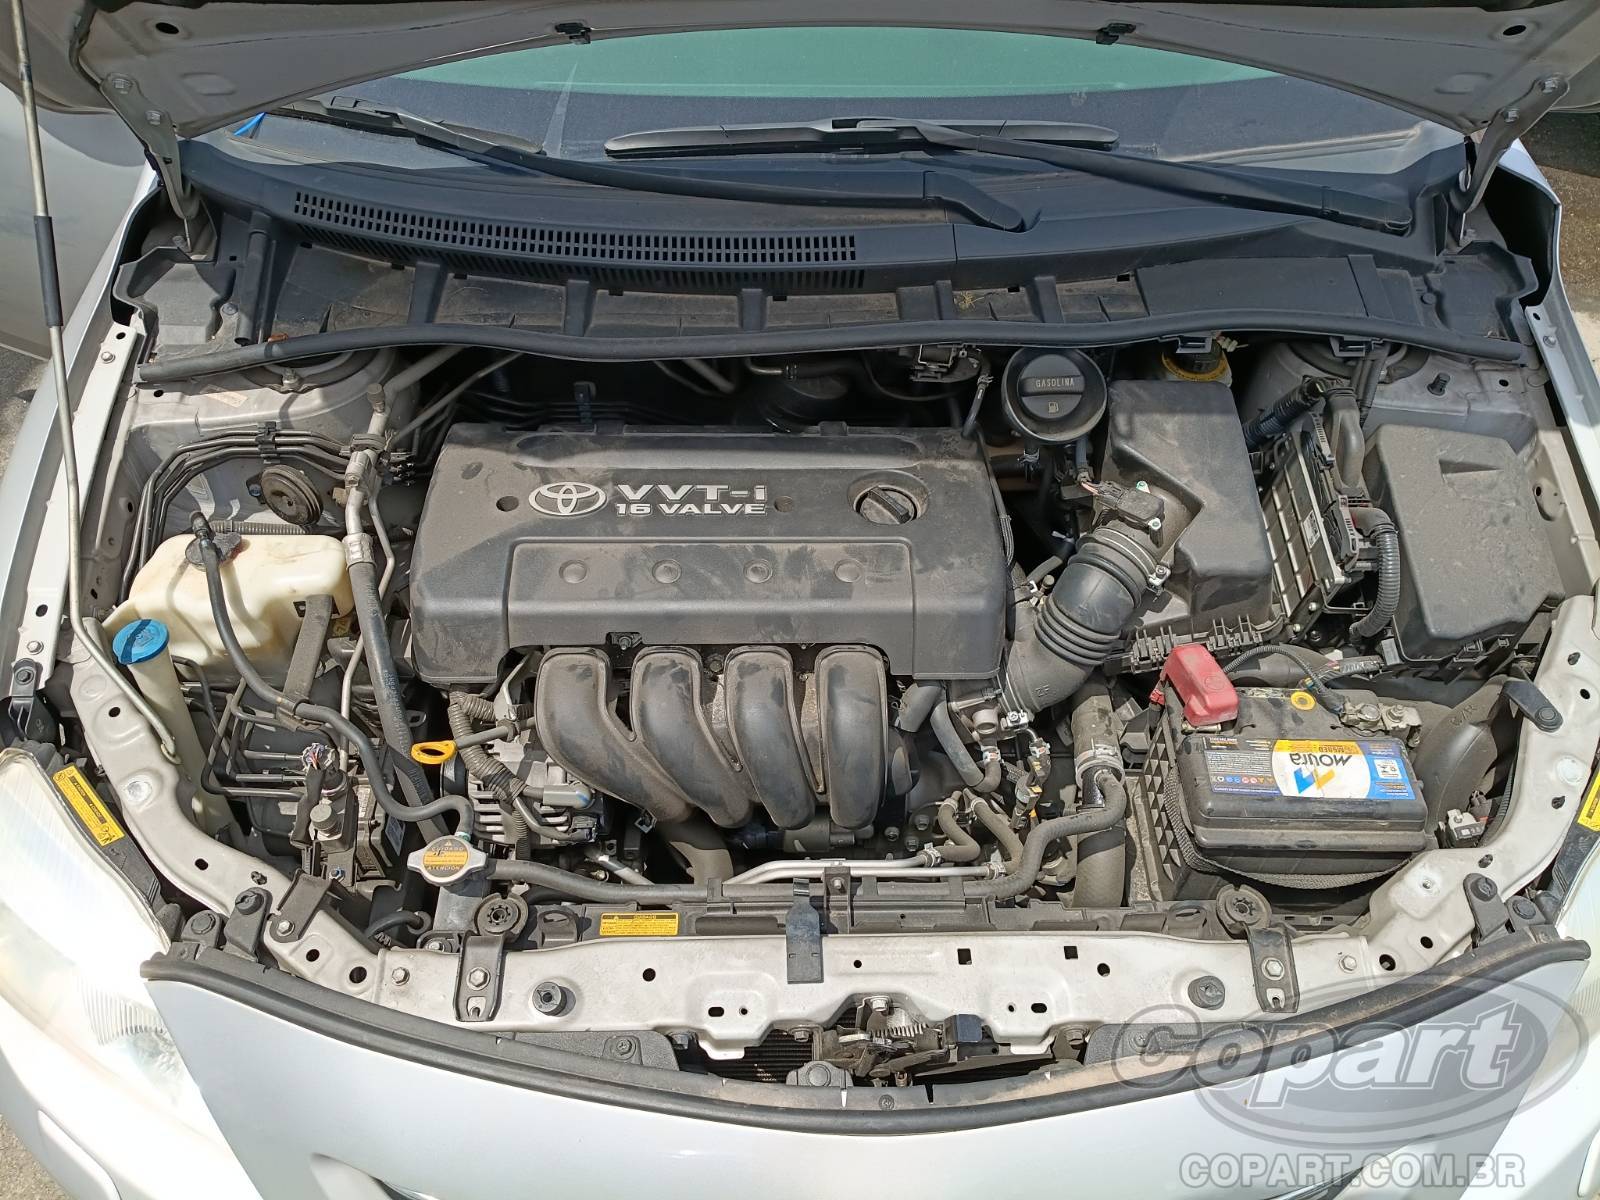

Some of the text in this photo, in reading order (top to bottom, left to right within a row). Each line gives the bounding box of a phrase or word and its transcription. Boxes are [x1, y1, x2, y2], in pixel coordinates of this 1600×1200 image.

[1035, 378, 1075, 387] GASOLINA
[616, 484, 767, 501] VVT-i
[616, 503, 767, 515] 16 VALVE
